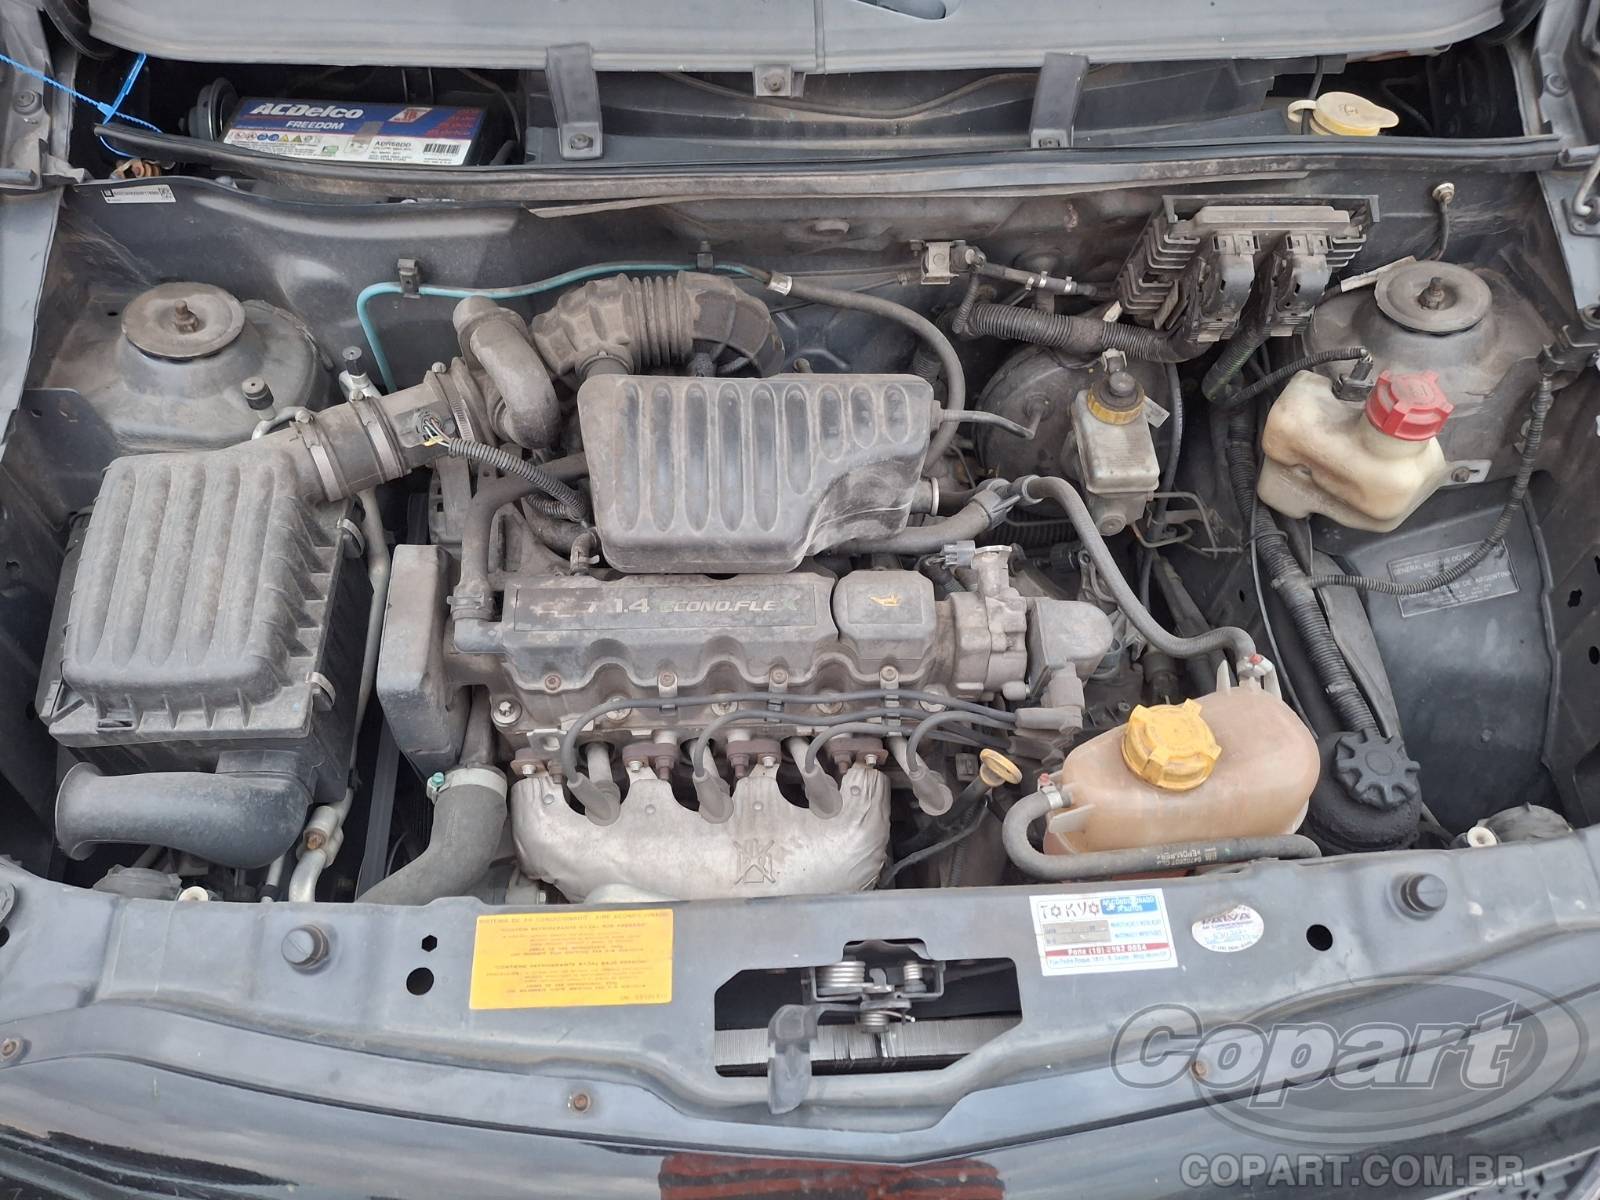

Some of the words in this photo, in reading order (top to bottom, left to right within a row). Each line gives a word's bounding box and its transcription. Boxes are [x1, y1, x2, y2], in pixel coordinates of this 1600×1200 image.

[249, 102, 364, 119] ACDelco
[285, 120, 345, 130] FREEDOM
[614, 598, 650, 613] 1.4
[1040, 901, 1100, 919] TOKYO
